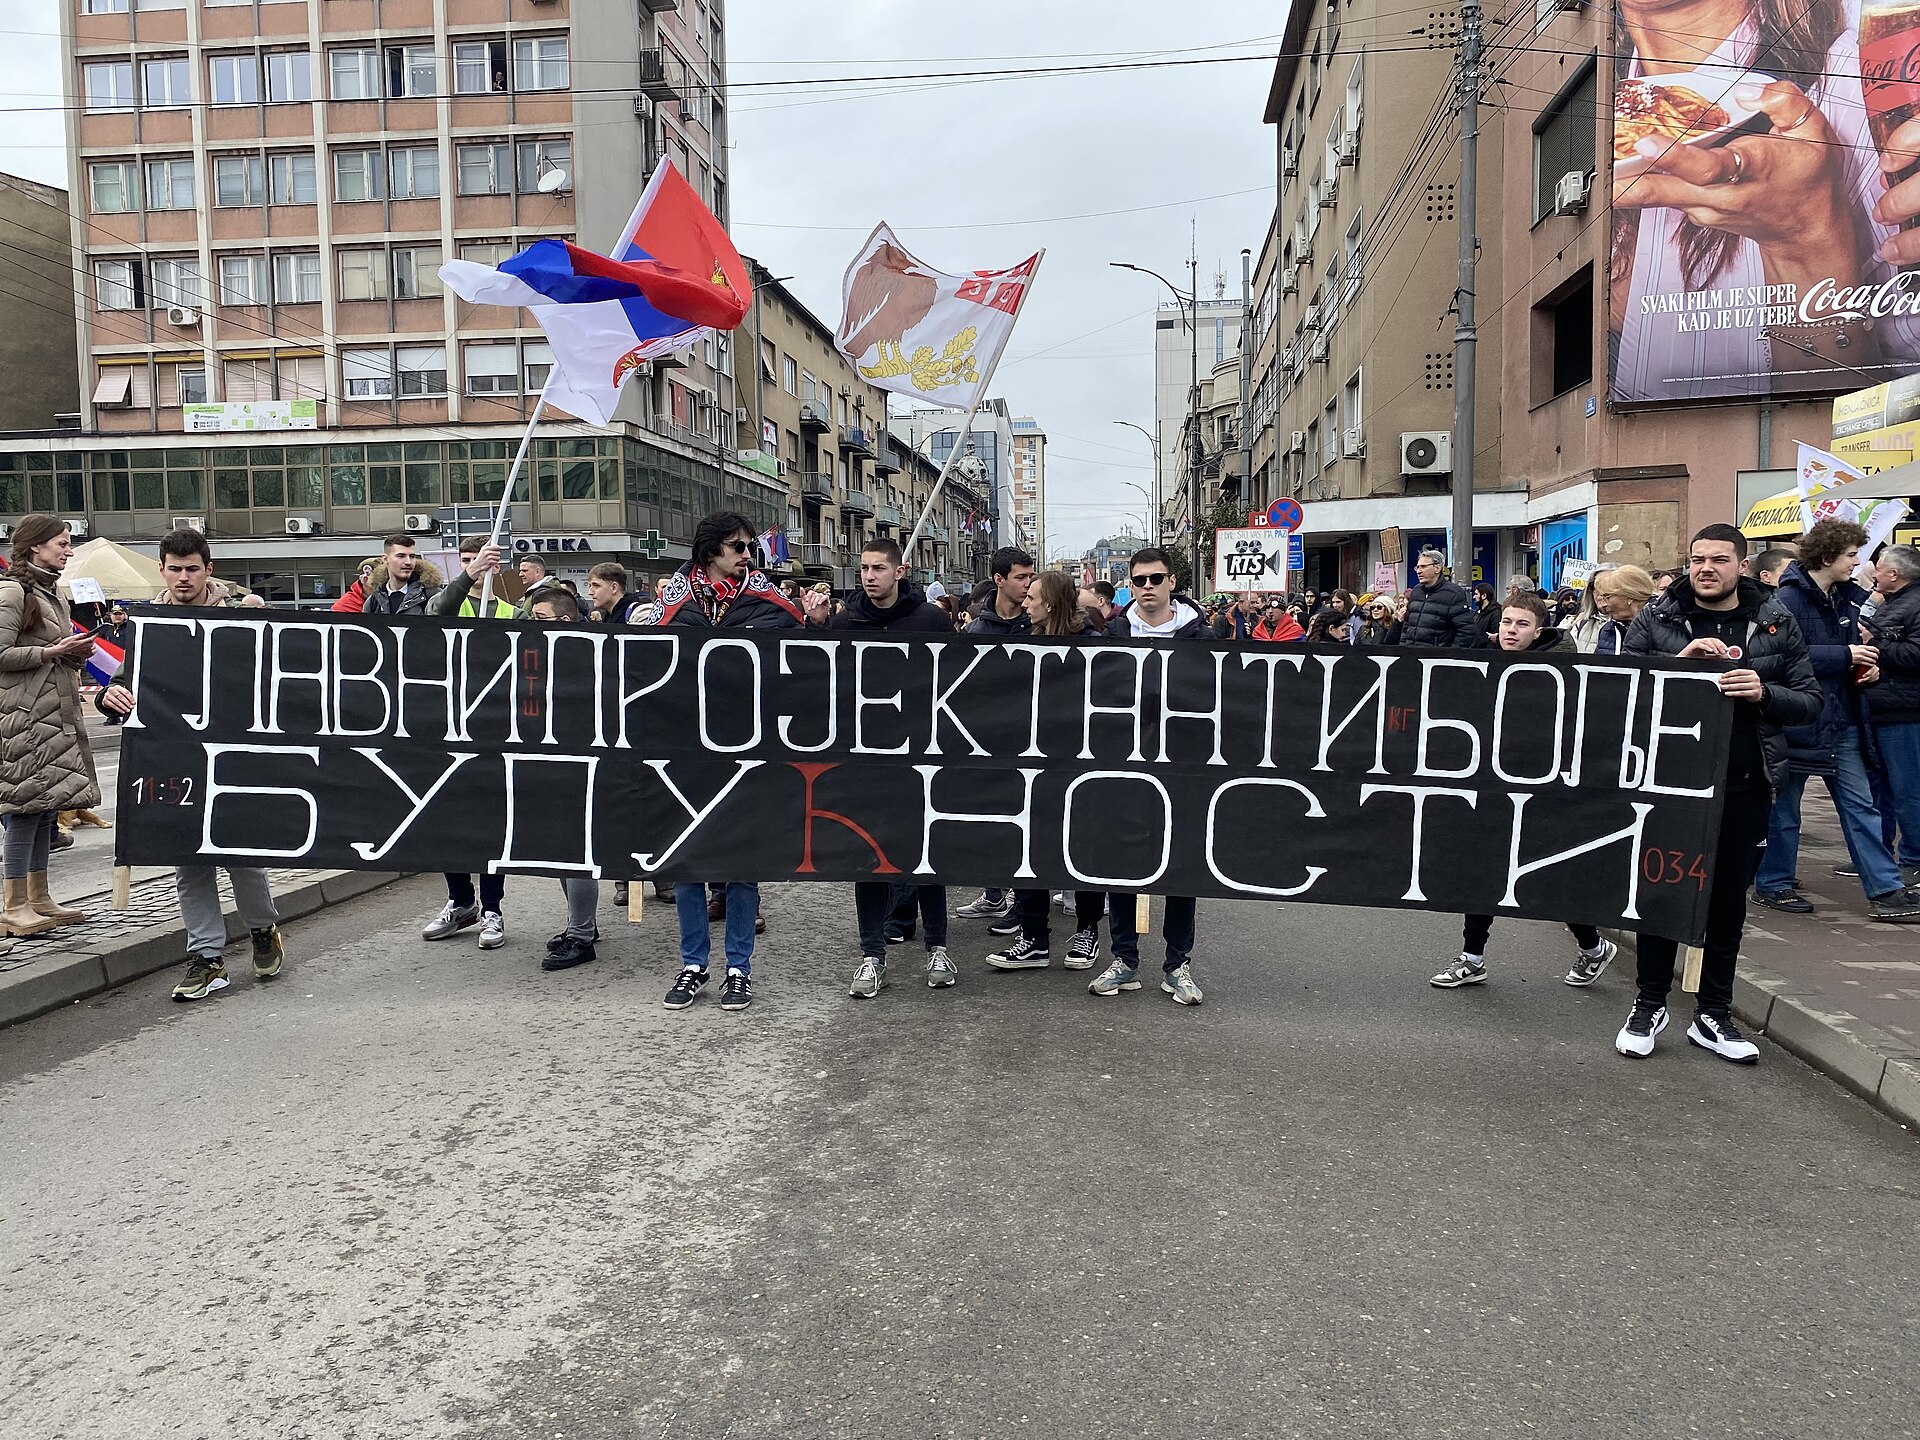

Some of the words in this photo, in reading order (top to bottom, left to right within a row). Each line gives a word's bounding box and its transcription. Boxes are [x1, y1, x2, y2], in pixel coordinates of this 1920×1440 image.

[1640, 292, 1685, 315] SVAKI
[1687, 289, 1723, 311] FILM
[1725, 287, 1744, 308] JE
[1747, 283, 1796, 306] SUPER
[1677, 311, 1710, 333] KAD
[1713, 310, 1731, 330] JE
[1735, 307, 1754, 328] UZ
[1757, 305, 1797, 327] TEBE
[1836, 420, 1862, 435] EXCHANGE
[1744, 500, 1801, 529] MENJAČNIC
[1229, 555, 1263, 574] RTS
[122, 616, 524, 745] ГЛАВНИ
[541, 630, 1400, 775] ПРОЈЕКТАНТИ
[1412, 658, 1722, 799] БОЉЕ
[132, 776, 194, 805] 11:52
[196, 742, 1655, 920] БУДУЋНОСТИ
[1643, 847, 1708, 892] 034
